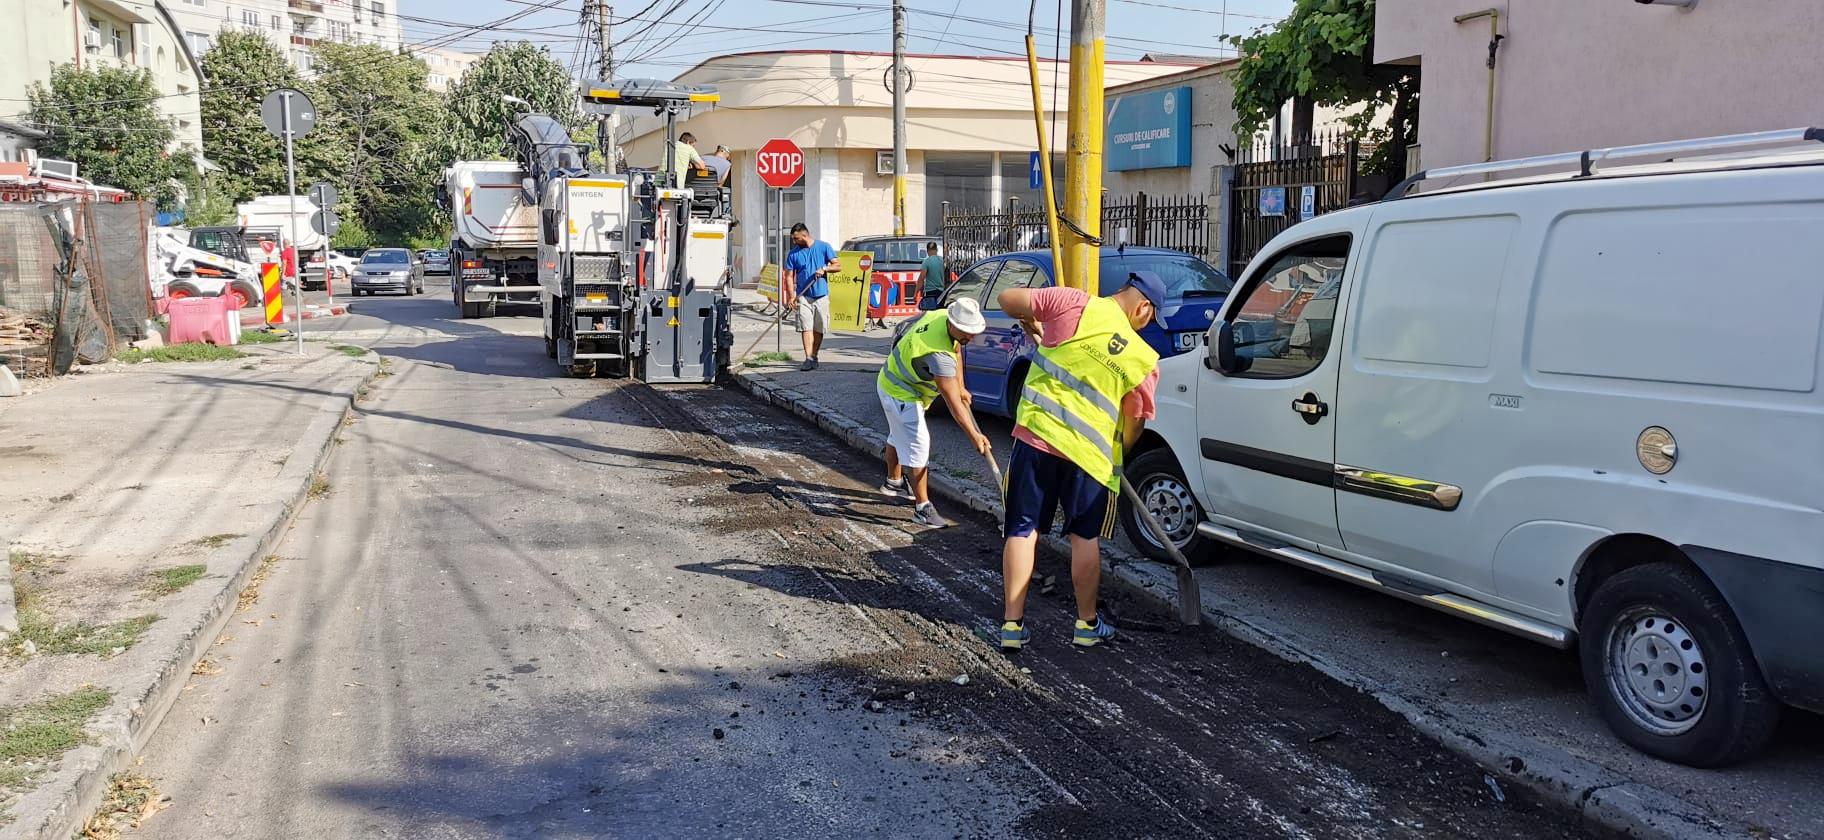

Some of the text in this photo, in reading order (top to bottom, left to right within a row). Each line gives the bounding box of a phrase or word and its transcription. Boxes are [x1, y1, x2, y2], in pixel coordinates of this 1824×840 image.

[1113, 127, 1171, 145] CURSURI DE CALIFICARE
[758, 152, 802, 174] STOP
[828, 273, 851, 285] Ocolire
[834, 313, 845, 321] 200
[1110, 338, 1125, 352] CT
[1182, 333, 1198, 347] CT
[1080, 342, 1108, 362] CONFORT
[1494, 395, 1520, 409] MAXI
